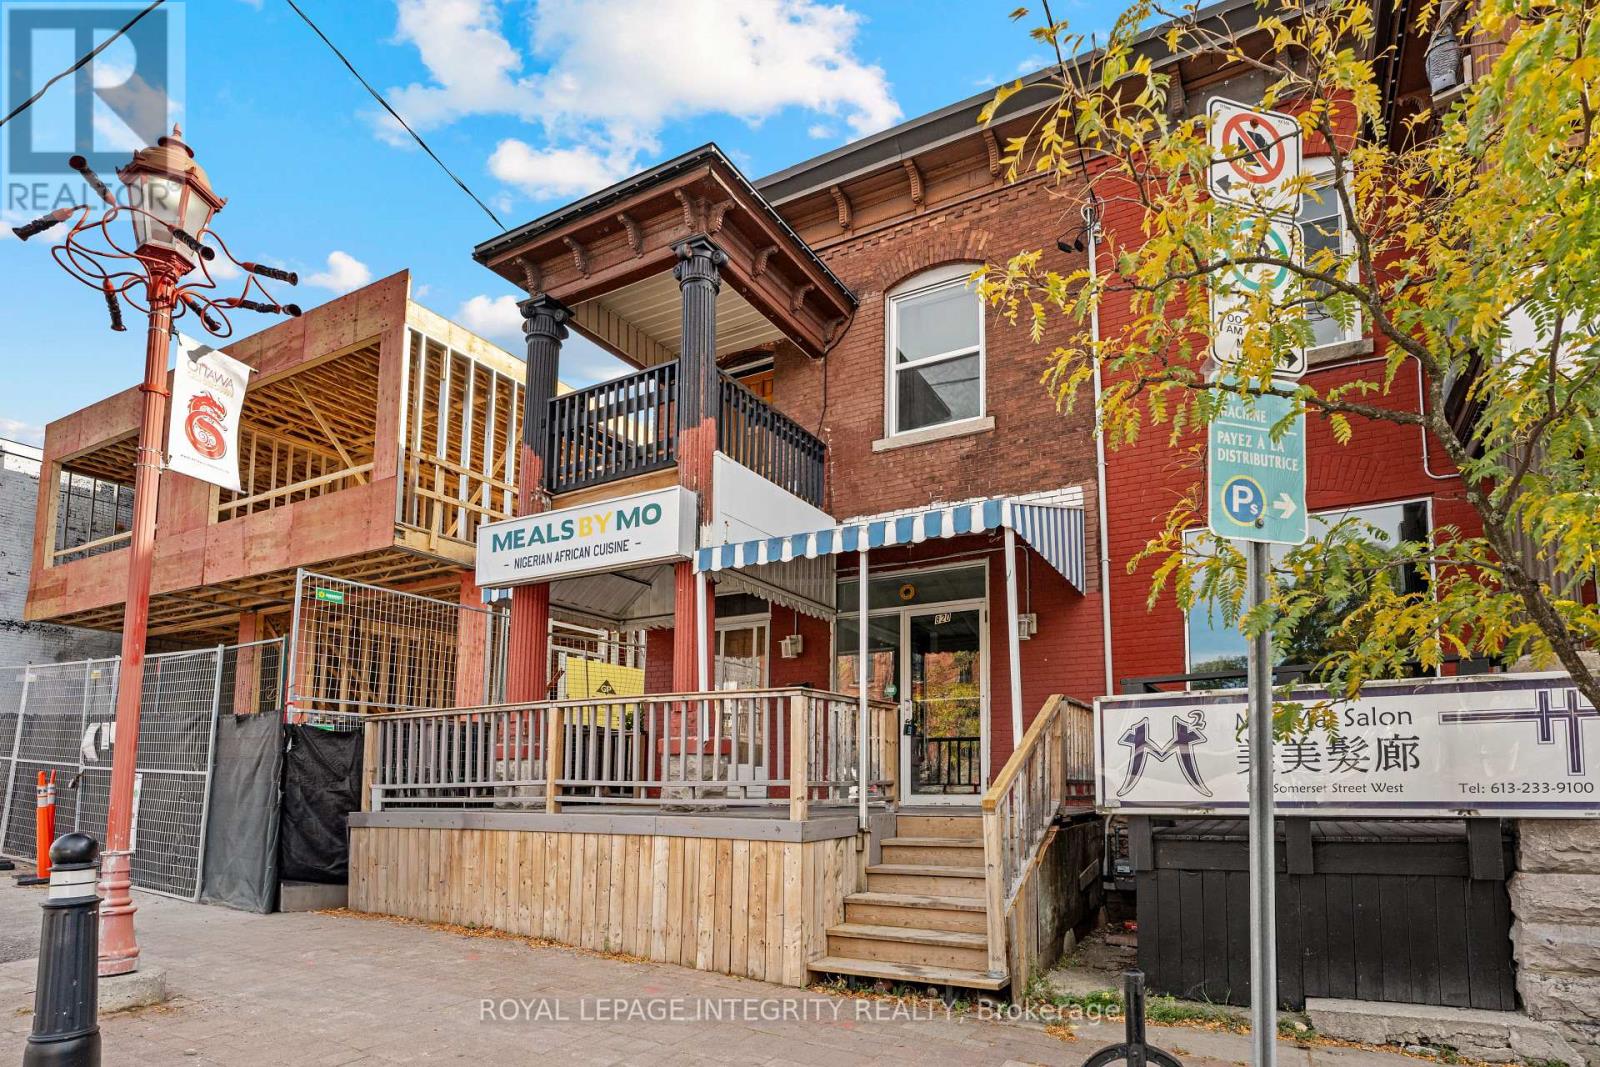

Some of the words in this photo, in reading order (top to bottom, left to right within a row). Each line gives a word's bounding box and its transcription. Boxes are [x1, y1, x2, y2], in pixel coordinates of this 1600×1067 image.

[1217, 430, 1252, 448] PAYEZ
[1217, 448, 1299, 472] DISTRIBUTRICE
[492, 519, 574, 553] MEALS
[578, 511, 613, 538] BY
[616, 503, 662, 531] MO
[514, 552, 552, 569] NIGERIAN
[555, 546, 590, 563] AFRICAN
[593, 539, 630, 555] CUISINE
[1345, 706, 1412, 727] Salon
[1273, 783, 1327, 793] Somerset
[1332, 782, 1366, 793] Street
[1371, 782, 1404, 793] West
[1458, 782, 1485, 794] Tel:
[1490, 781, 1594, 794] 613-233-9100
